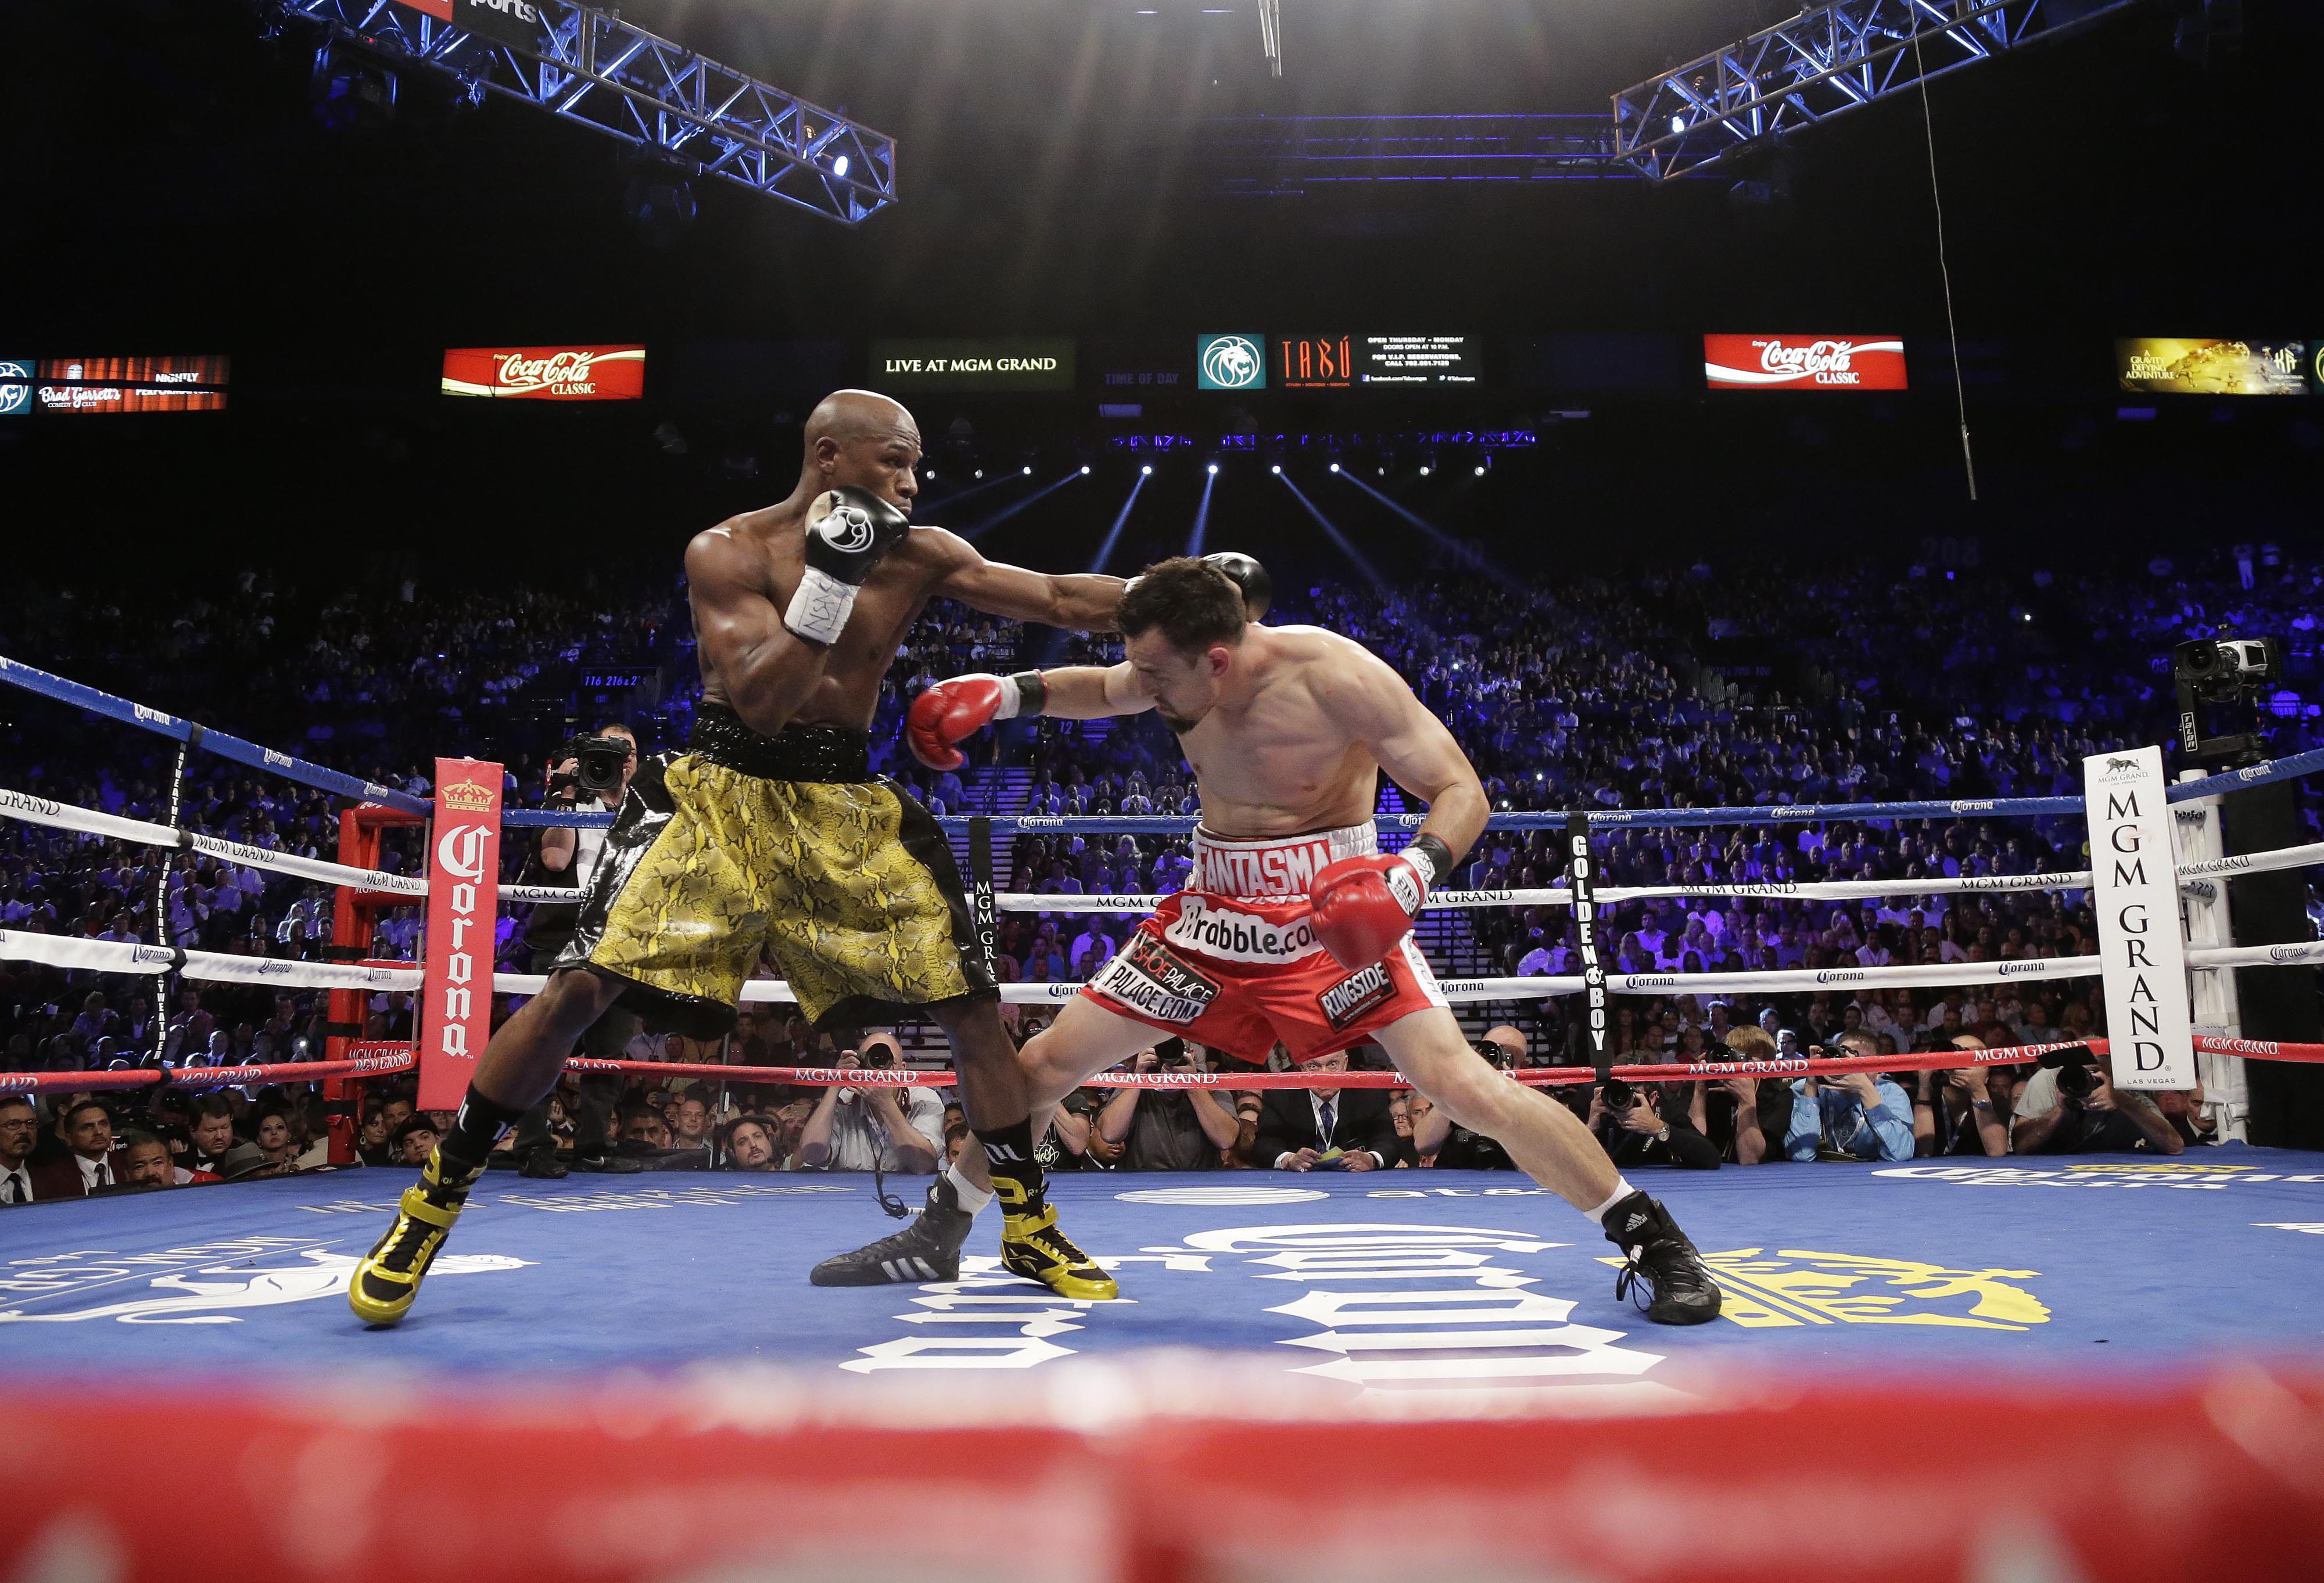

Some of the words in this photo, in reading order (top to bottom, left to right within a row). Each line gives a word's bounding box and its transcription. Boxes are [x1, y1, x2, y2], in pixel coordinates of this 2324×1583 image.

[1761, 340, 1852, 371] Coca-Cola
[499, 351, 594, 384] Coca-Cola
[885, 359, 921, 372] LIVE
[925, 359, 948, 372] AT
[950, 358, 994, 372] MGM
[996, 358, 1057, 371] GRAND
[2131, 363, 2167, 372] DEFYING
[155, 372, 199, 383] NIGHTLY
[1105, 373, 1134, 385] TIME
[1139, 373, 1153, 385] OF
[1157, 373, 1179, 385] DAY
[1815, 372, 1860, 384] CLASSIC
[2126, 371, 2175, 379] ADVENTURE
[551, 383, 596, 395] CLASSIC
[38, 386, 70, 403] Brad
[71, 386, 121, 407] Garrett's
[585, 676, 602, 686] 116
[605, 676, 623, 686] 216
[133, 702, 170, 726] Corona
[264, 748, 292, 768] Corona
[2239, 763, 2272, 781] Corona
[169, 742, 187, 827] MAYWEATHE
[1771, 806, 1815, 819] Corona
[1950, 799, 1995, 813] Corona
[1017, 816, 1064, 830] Corona
[1587, 812, 1633, 824] Corona
[195, 835, 228, 854] MGM
[2106, 789, 2151, 888] MGM
[2179, 863, 2207, 875] MGM
[363, 873, 389, 888] MGM
[1960, 878, 2003, 889] MGM
[512, 888, 558, 899] MGM
[1682, 884, 1727, 894] MGM
[975, 880, 994, 925] MGM
[1096, 897, 1144, 908] MGM
[437, 824, 495, 1058] Corona
[1572, 835, 1598, 964] GOLDEN
[1590, 987, 1605, 1051] BOY
[132, 945, 171, 965] Corona
[2270, 946, 2305, 961] Corona
[257, 959, 292, 975] Corona
[1998, 961, 2045, 976] Corona
[368, 967, 392, 982] Corona
[1816, 970, 1864, 985] Corona
[1437, 980, 1485, 995] Corona
[1625, 975, 1674, 989] Corona
[2118, 904, 2165, 1071] GRAND
[1321, 961, 1390, 1020] RINGSIDE
[2201, 1036, 2232, 1051] MGM
[1974, 1047, 2019, 1061] MGM
[352, 1060, 378, 1072] MGM
[1689, 1063, 1735, 1075] MGM
[794, 1069, 843, 1082] MGM
[1091, 1072, 1143, 1083] MGM
[1365, 1188, 1553, 1198] at&
